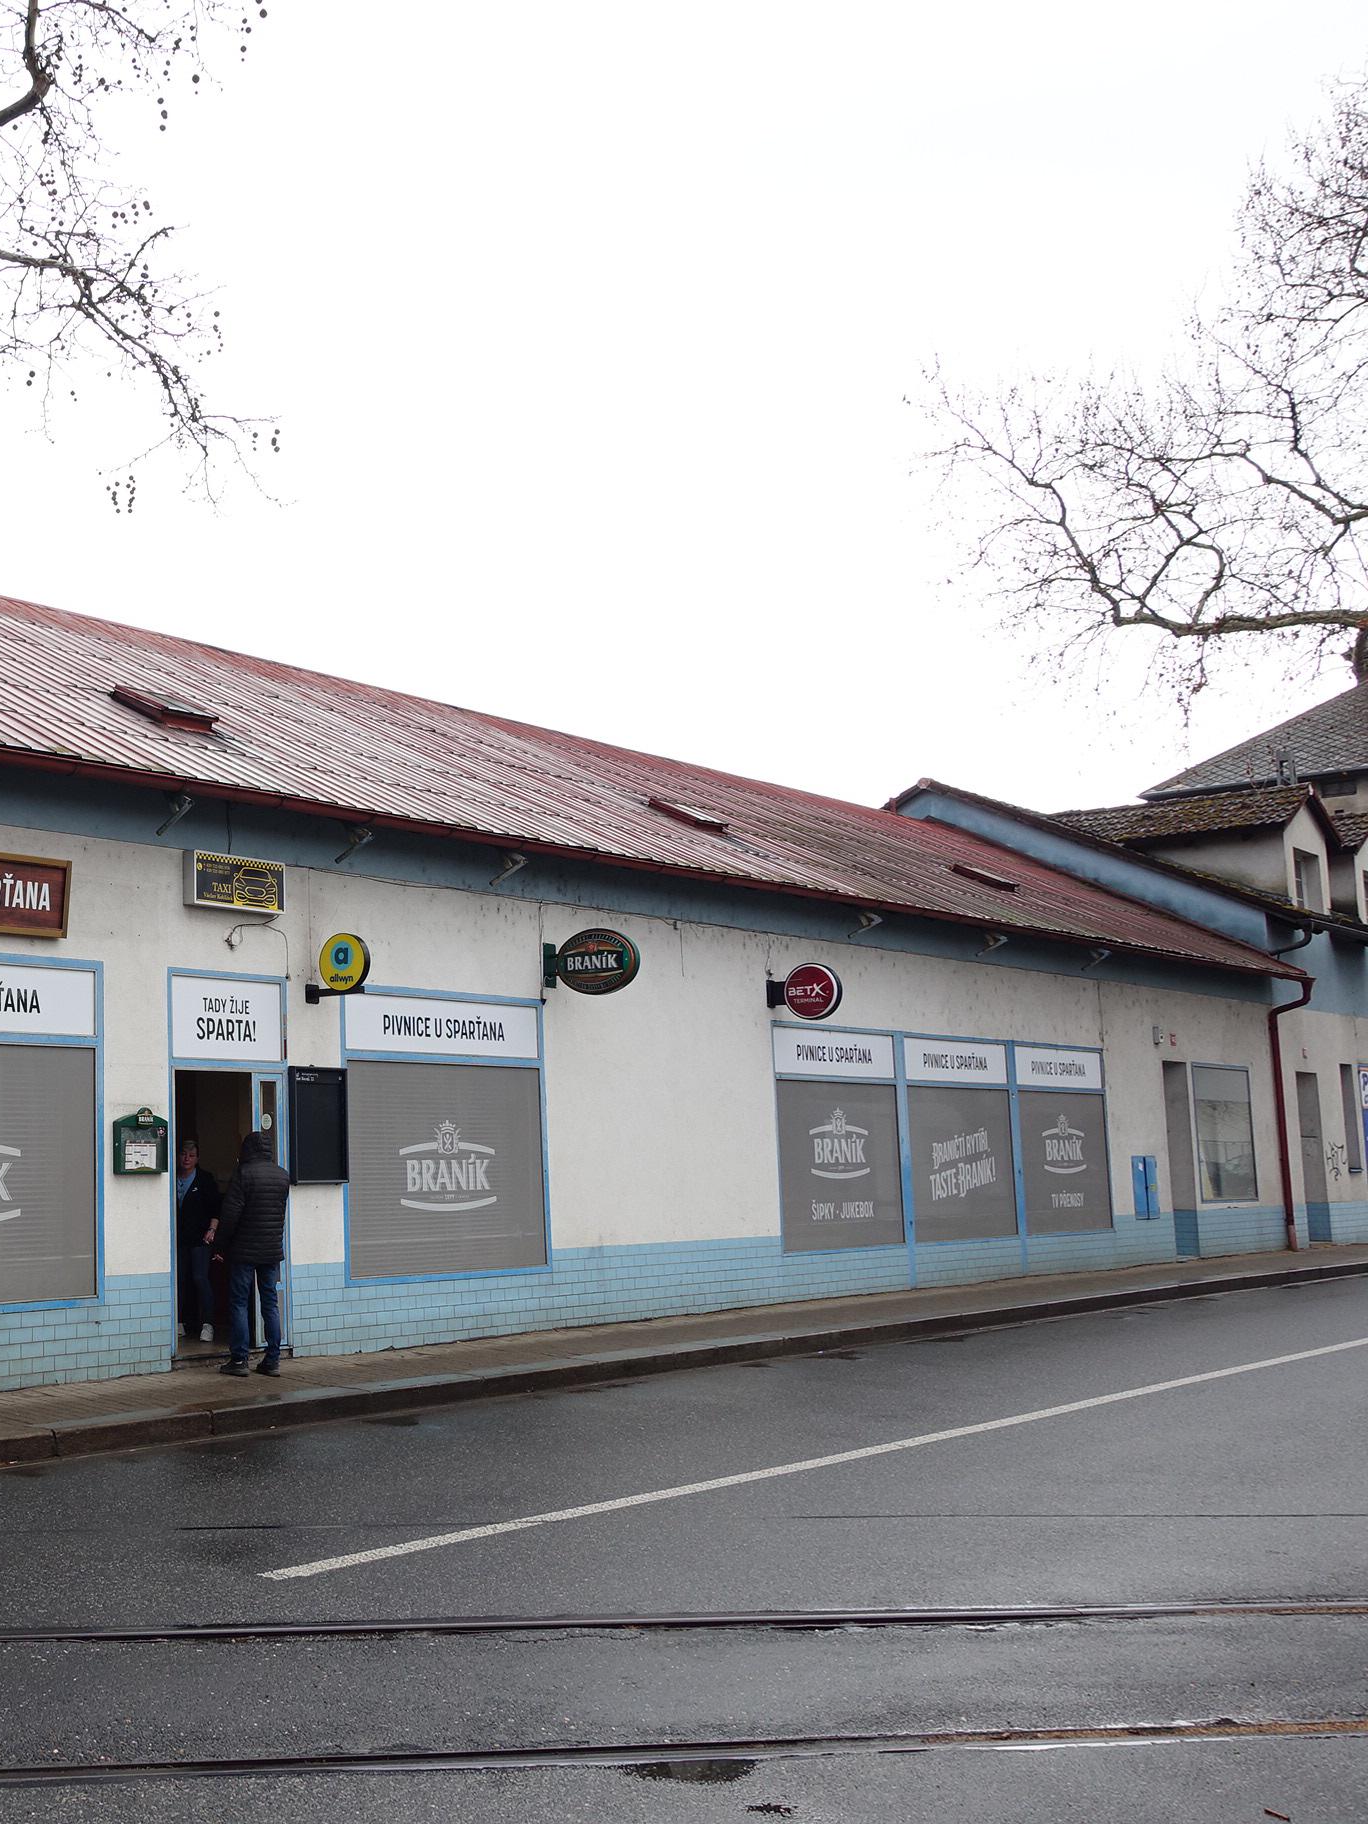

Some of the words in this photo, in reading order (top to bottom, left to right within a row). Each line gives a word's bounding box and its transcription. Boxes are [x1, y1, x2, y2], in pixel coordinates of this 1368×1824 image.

[212, 882, 232, 893] TAXI
[567, 951, 618, 971] BRANÍK
[329, 973, 354, 984] allwyn
[788, 980, 829, 997] BETX
[202, 997, 227, 1013] TADY
[229, 995, 250, 1014] ŽIJE
[196, 1016, 257, 1042] SPARTA!
[383, 1014, 431, 1037] PIVNICE
[435, 1018, 442, 1038] U
[446, 1016, 505, 1041] SPARŤANA
[796, 1044, 827, 1062] PIVNICE
[828, 1047, 834, 1062] U
[835, 1044, 873, 1064] SPARŤANA
[923, 1053, 949, 1069] PIVNICE
[950, 1055, 955, 1070] U
[956, 1053, 988, 1071] SPARŤANA
[1032, 1060, 1053, 1076] PIVNICE
[1054, 1062, 1058, 1076] U
[1059, 1060, 1086, 1077] SPARŤANA
[814, 1134, 866, 1163] BRANÍK
[1045, 1136, 1083, 1161] BRANÍK
[406, 1153, 491, 1192] BRANÍK
[929, 1168, 958, 1200] TASTE
[958, 1154, 996, 1198] BRANÍK!
[812, 1200, 835, 1220] ŠIPKY
[840, 1201, 874, 1219] JUKEBOX
[1051, 1193, 1059, 1208] TV
